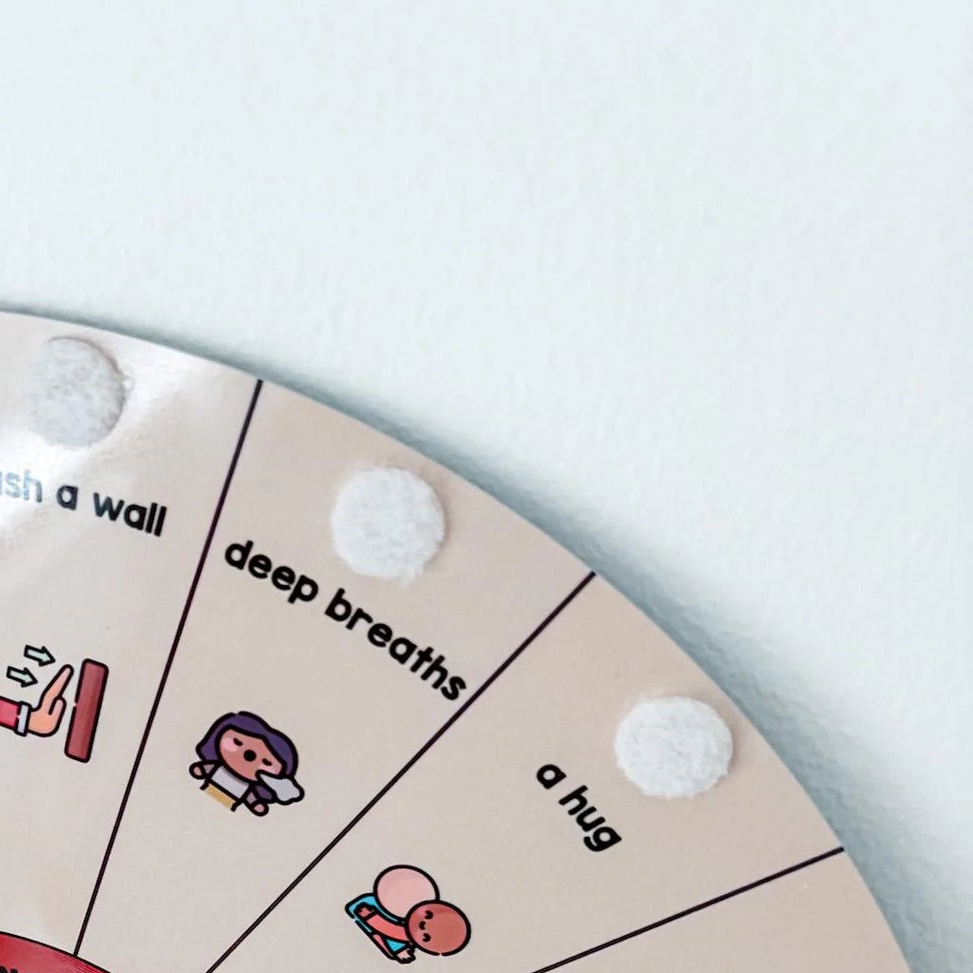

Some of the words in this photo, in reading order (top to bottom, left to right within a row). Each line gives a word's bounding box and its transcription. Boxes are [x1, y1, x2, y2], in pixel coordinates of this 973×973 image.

[56, 484, 80, 511] a
[93, 490, 167, 536] wall
[225, 541, 319, 604] deep
[324, 588, 467, 702] breaths
[536, 764, 567, 790] a
[558, 785, 622, 852] hug
